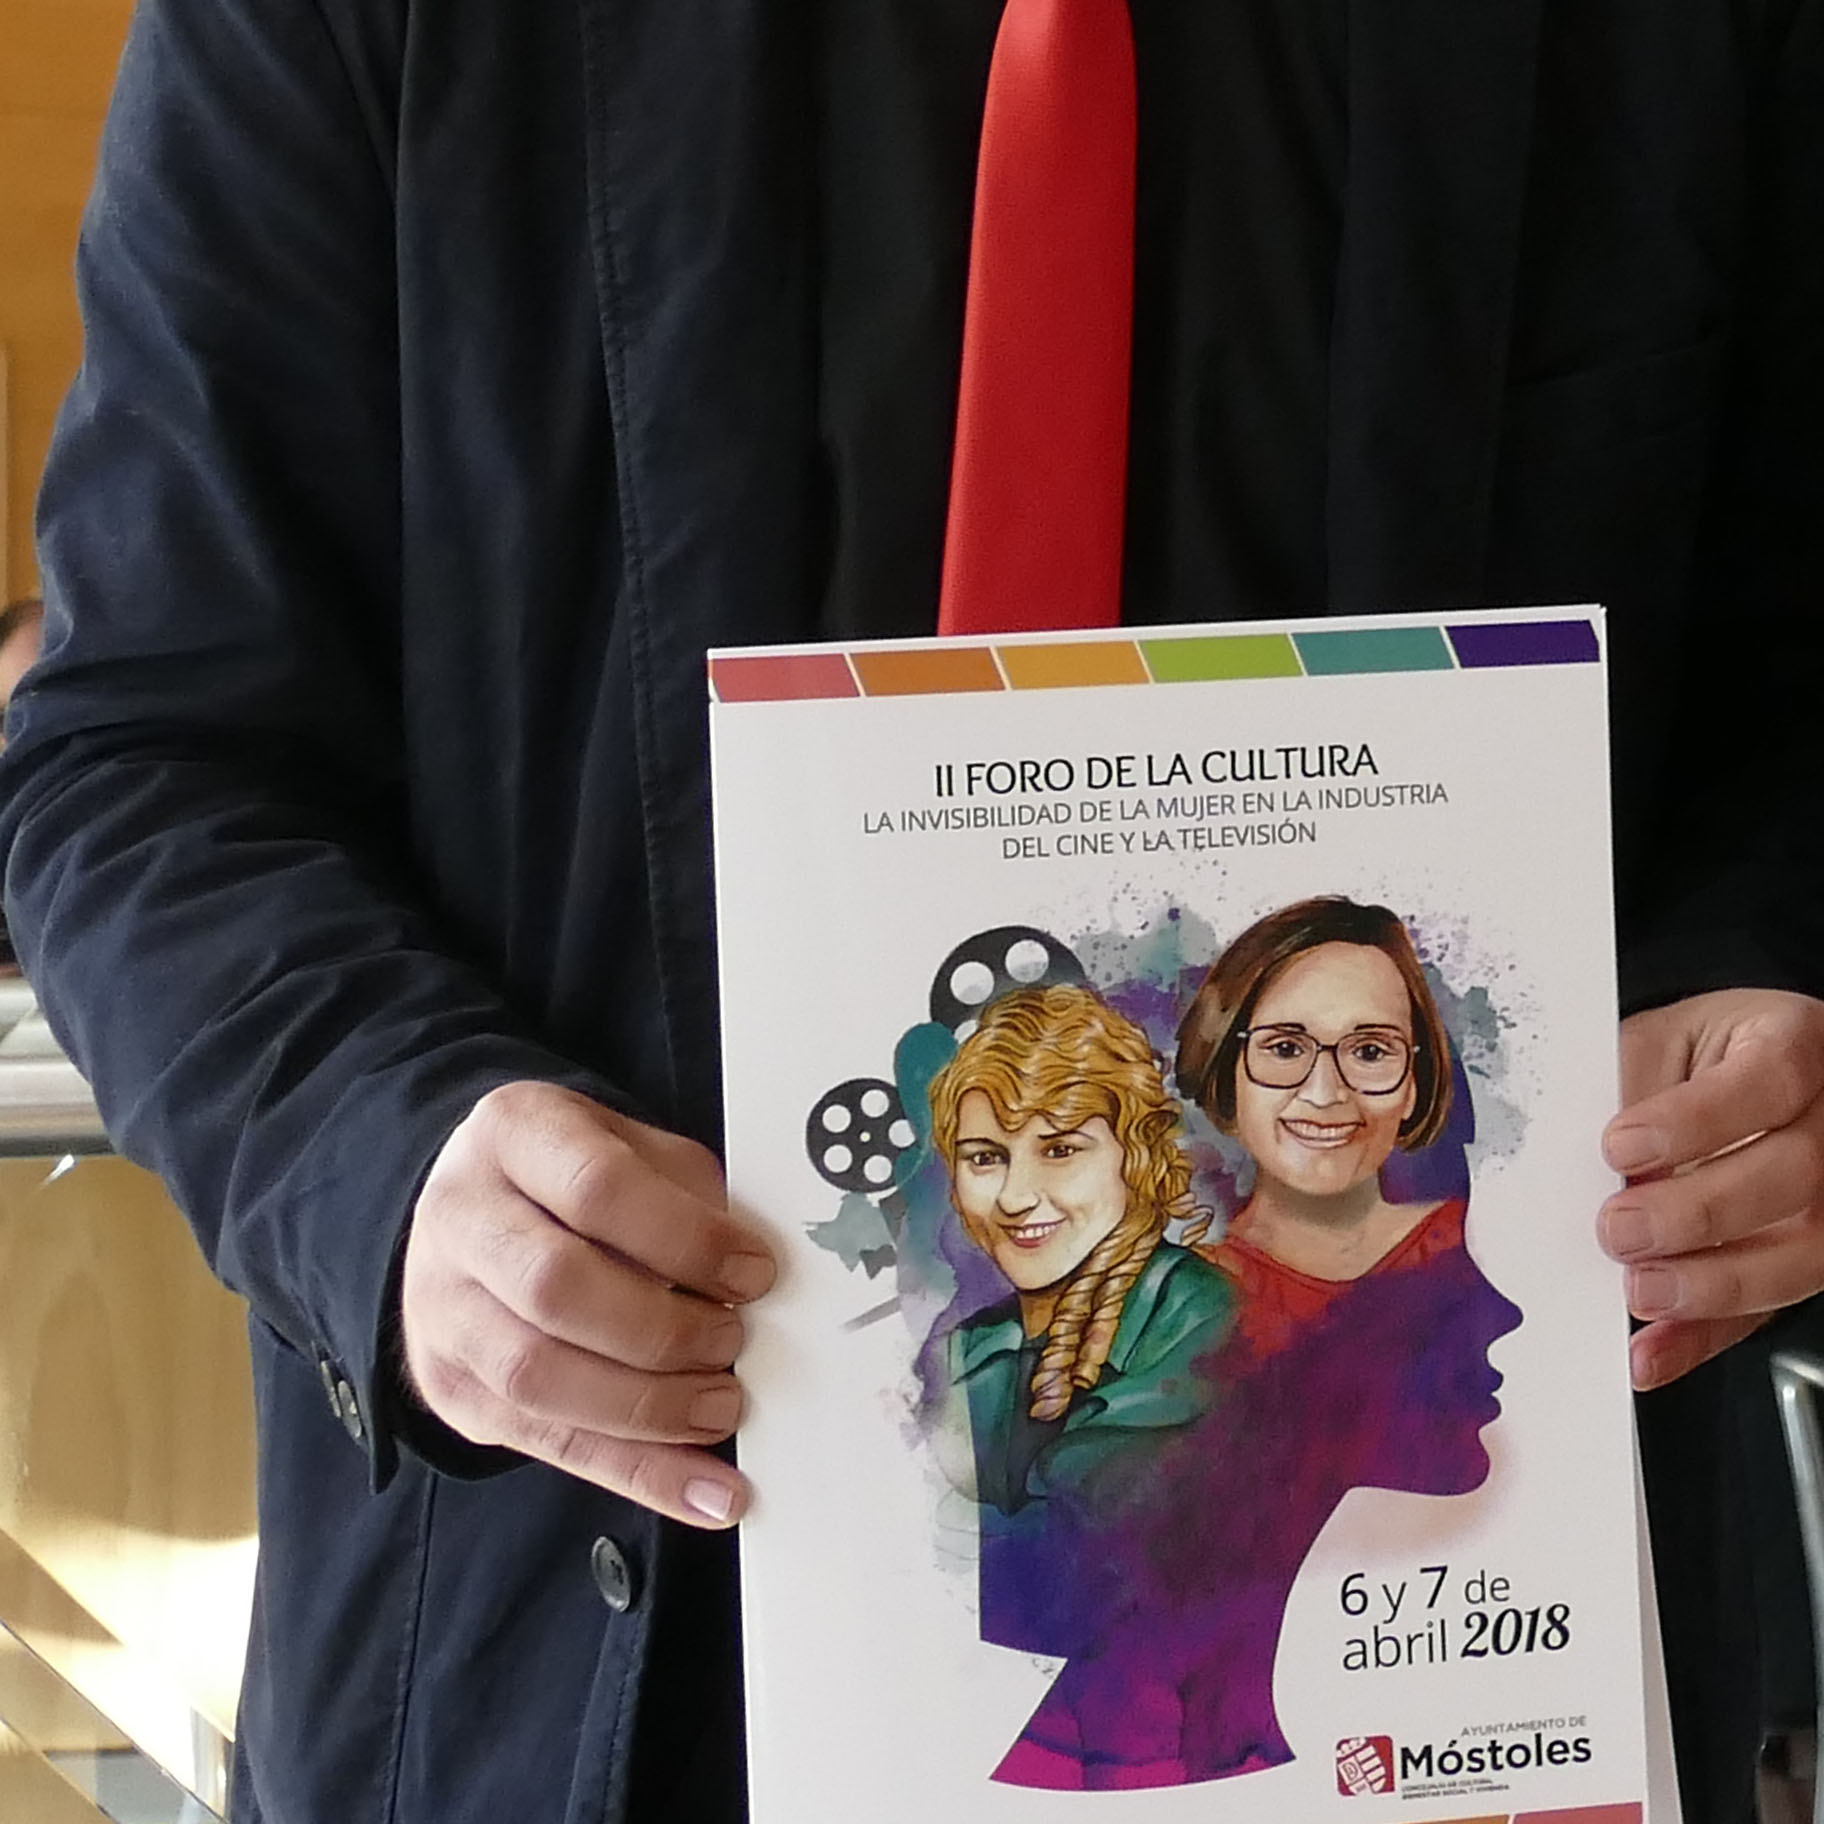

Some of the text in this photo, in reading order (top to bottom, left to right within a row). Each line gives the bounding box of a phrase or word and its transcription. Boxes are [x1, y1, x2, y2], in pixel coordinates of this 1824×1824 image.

[936, 743, 1379, 797] II FORO DE LA CULTURA
[864, 783, 1448, 834] LA INVISIBILIDAD DE LA MUJER EN LA INDUSTRIA
[1003, 818, 1316, 859] DEL CINE Y LA TELEVISIÓN
[1341, 1564, 1511, 1624] 6 y 7 de
[1343, 1603, 1571, 1671] abril 2018
[1461, 1715, 1587, 1738] AYUNTAMIENTO DE
[1401, 1732, 1592, 1779] Móstoles
